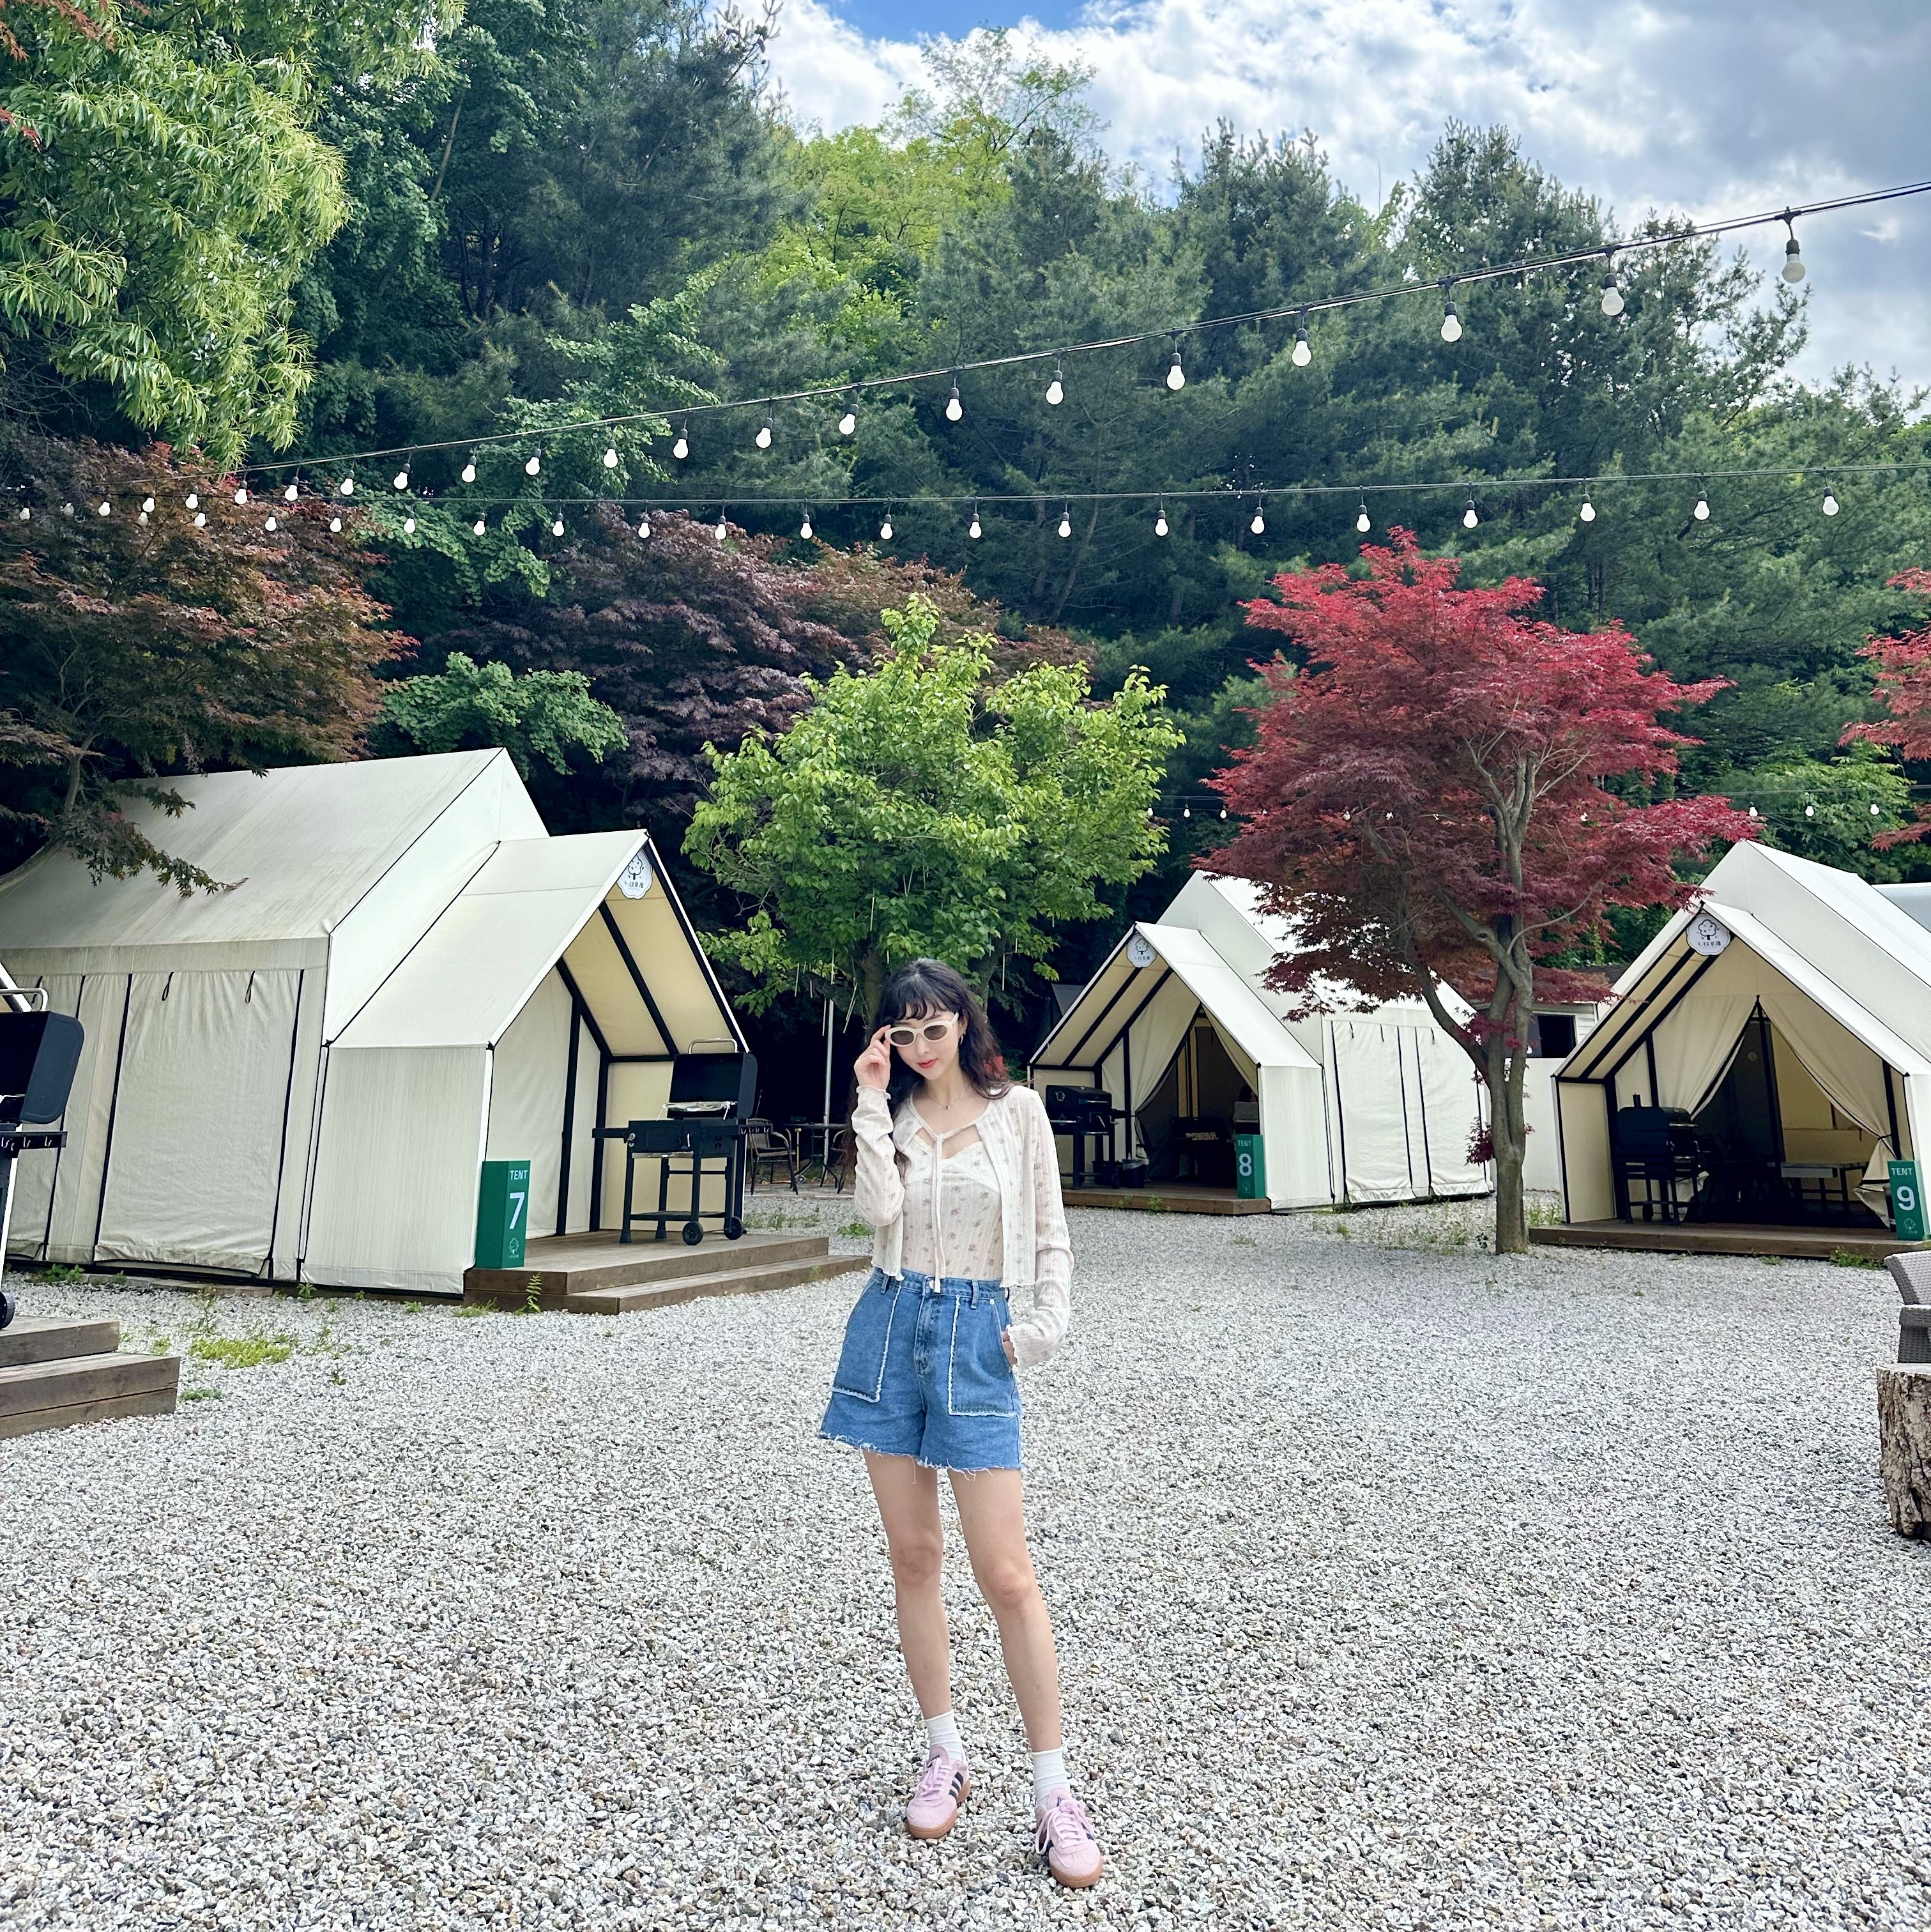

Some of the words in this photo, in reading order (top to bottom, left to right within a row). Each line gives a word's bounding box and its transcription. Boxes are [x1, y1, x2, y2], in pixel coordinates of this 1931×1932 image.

[510, 1169, 528, 1180] TENT
[1239, 1153, 1252, 1176] 8
[1891, 1167, 1912, 1176] TENT
[1897, 1185, 1916, 1211] 9
[509, 1192, 525, 1229] 7
